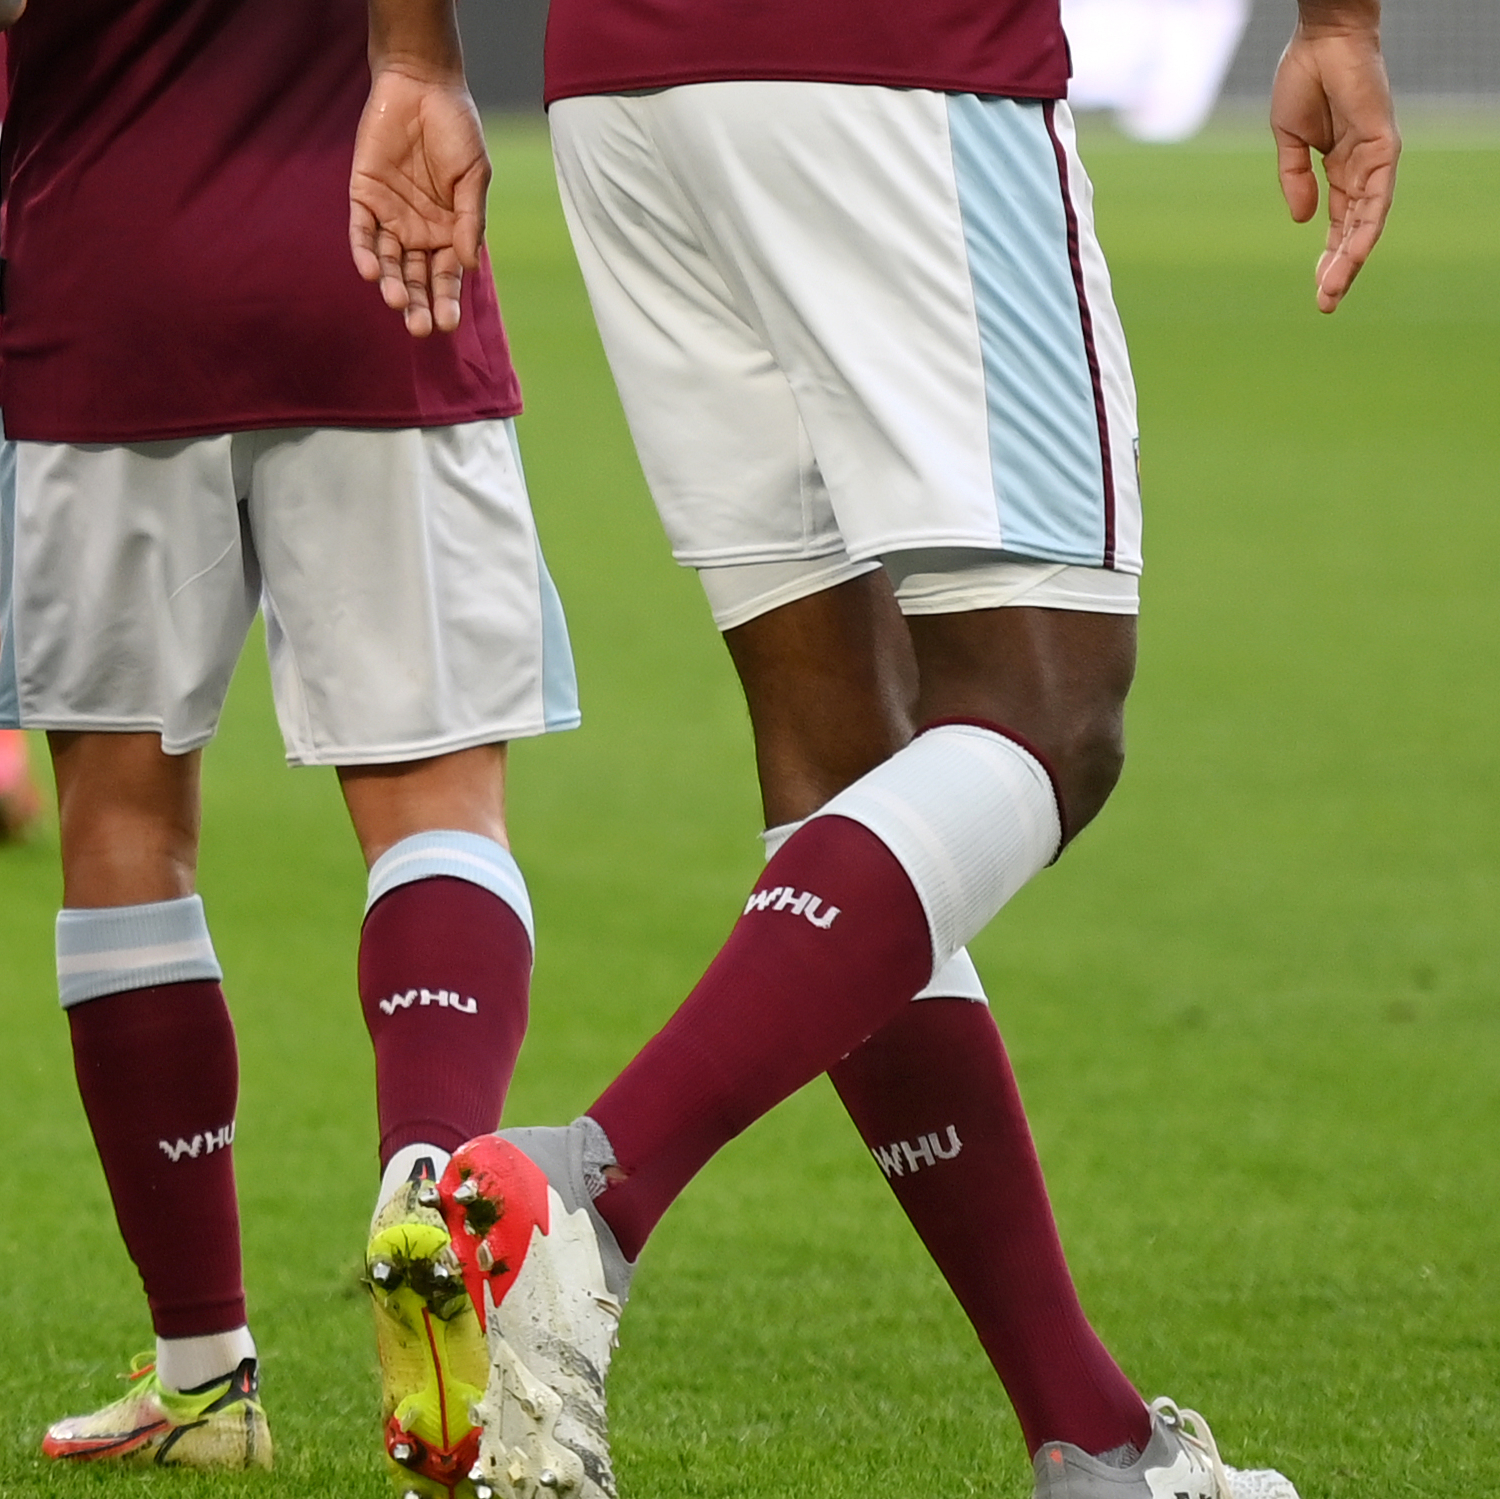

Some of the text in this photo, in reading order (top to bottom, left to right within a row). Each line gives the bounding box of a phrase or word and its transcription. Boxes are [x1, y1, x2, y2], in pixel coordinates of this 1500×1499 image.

[743, 886, 841, 930] WHU
[379, 989, 478, 1016] WHU
[159, 1119, 236, 1163] WHU
[872, 1124, 963, 1178] WHU
